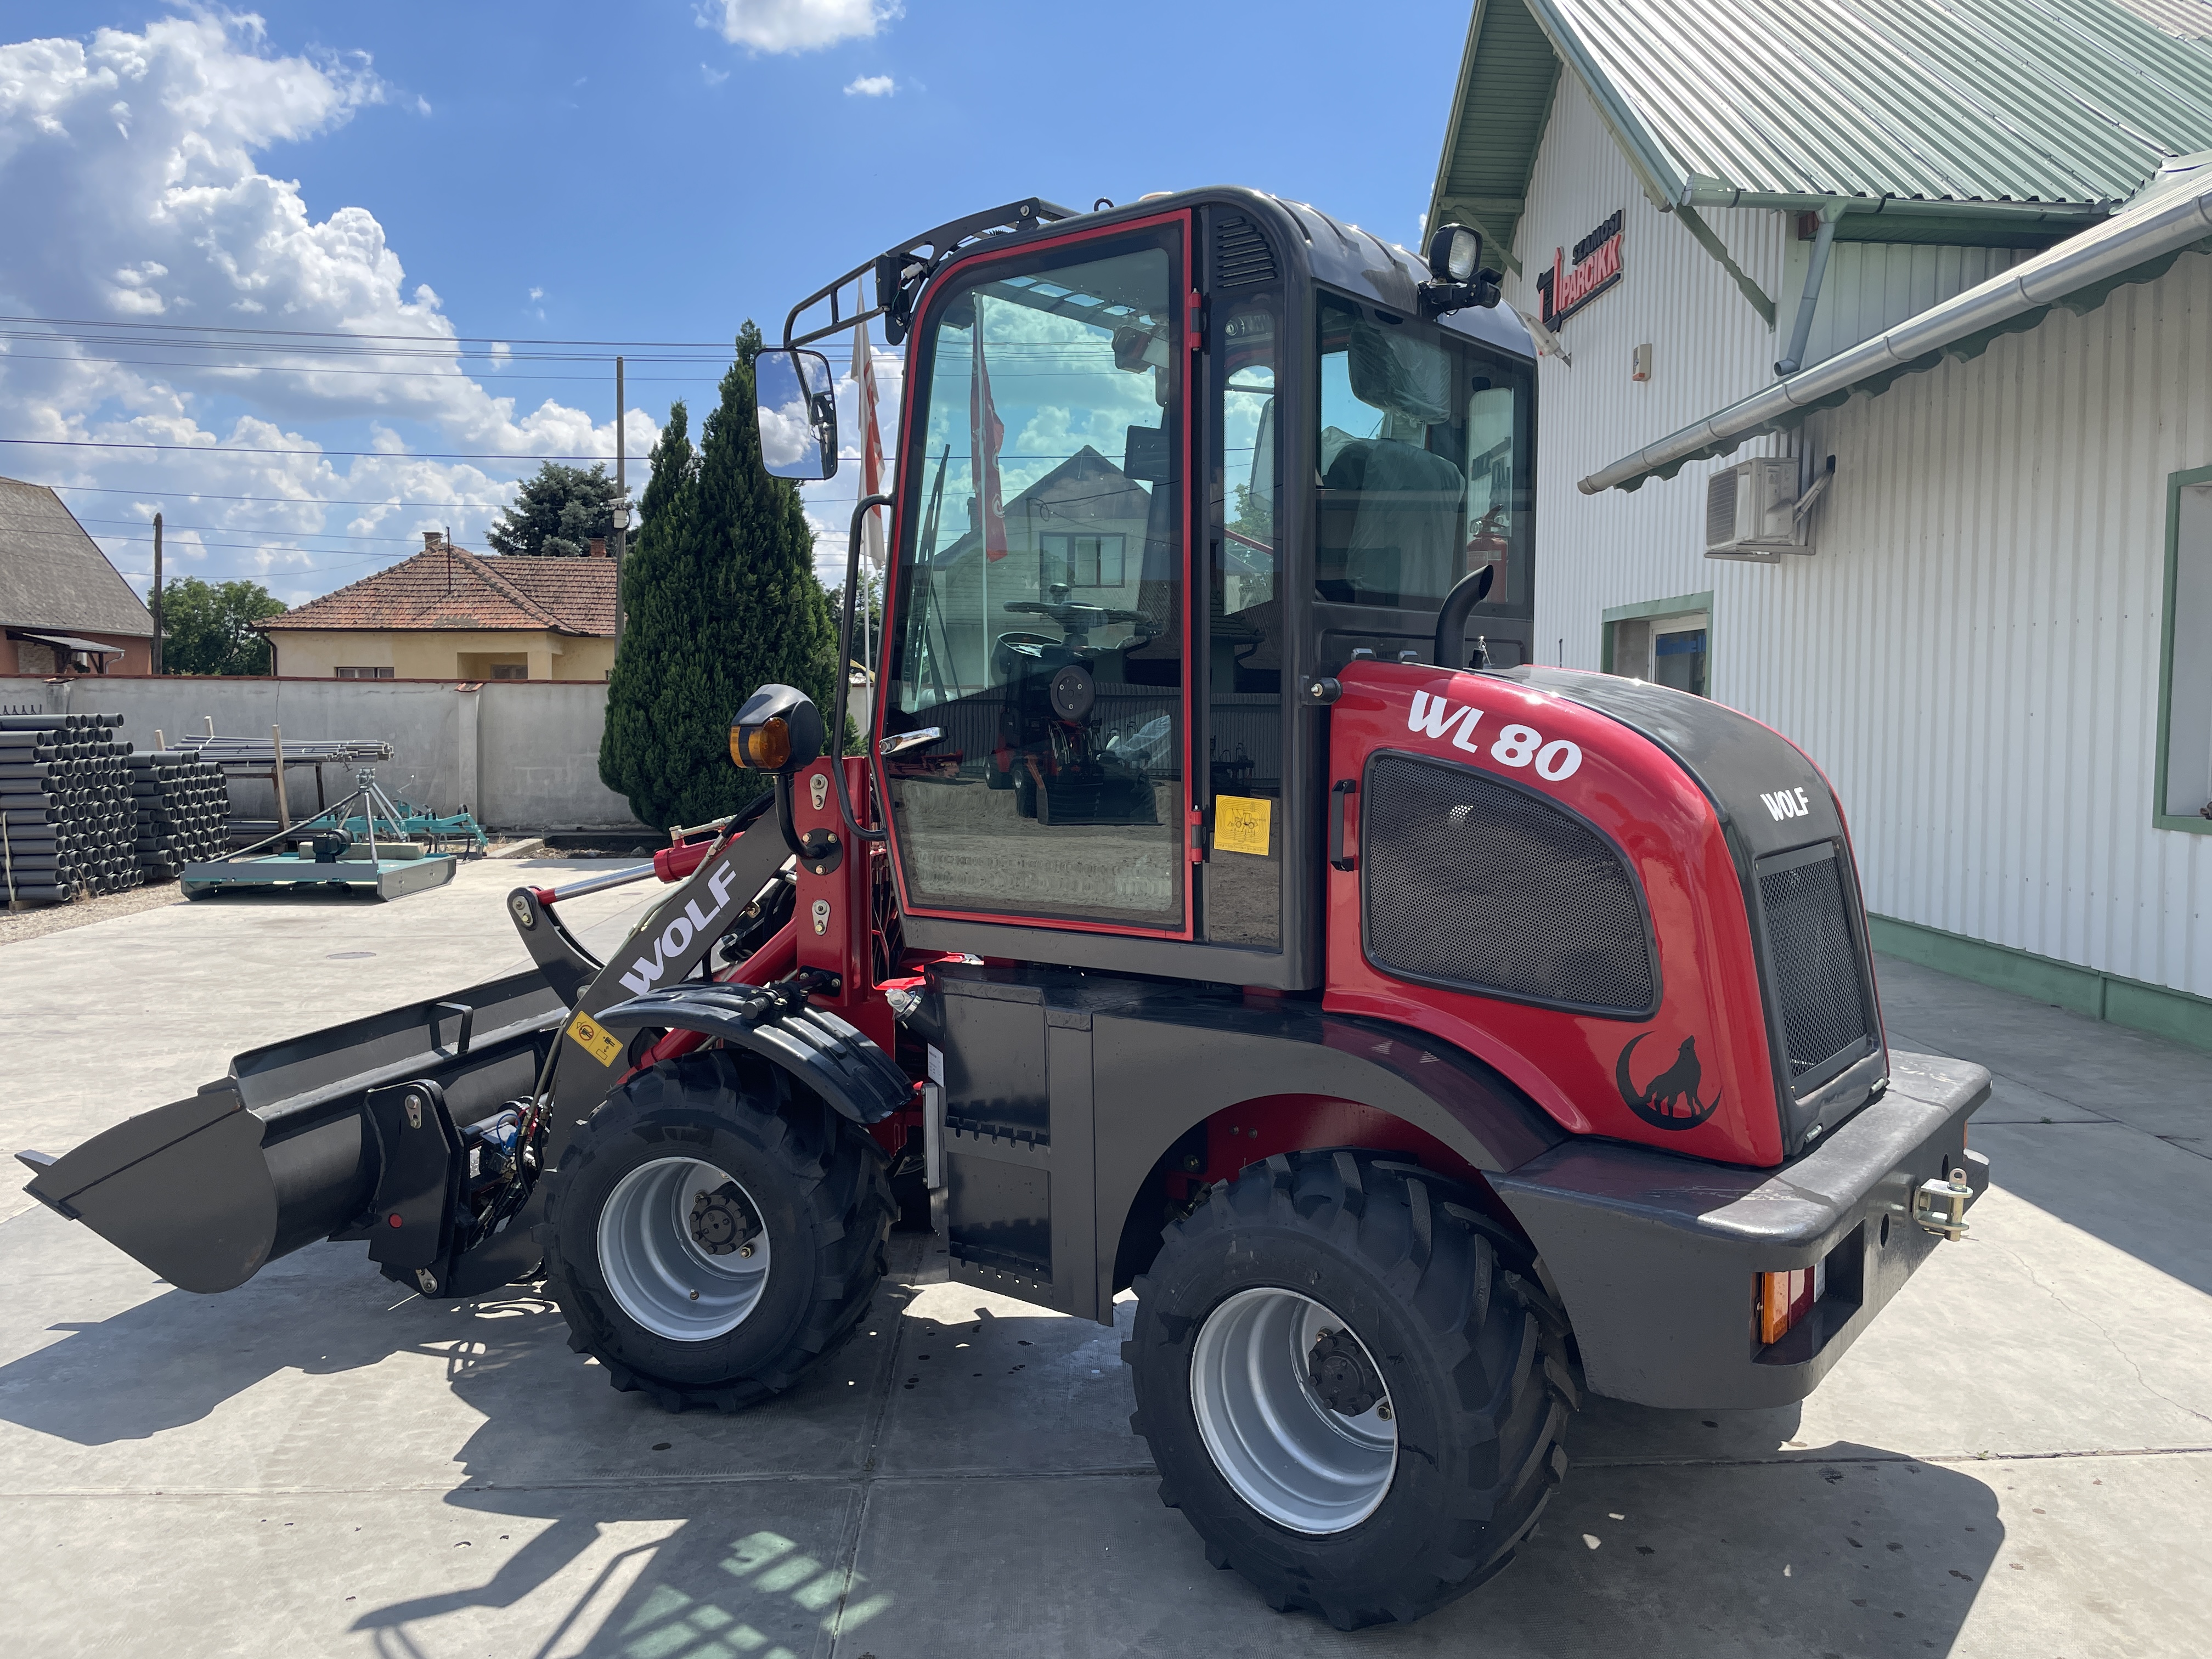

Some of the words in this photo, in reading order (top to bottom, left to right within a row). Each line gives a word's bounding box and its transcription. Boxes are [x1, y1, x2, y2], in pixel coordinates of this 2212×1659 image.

[1572, 210, 1622, 265] SZAMOSI
[1408, 690, 1485, 753] WL
[1491, 724, 1582, 781] 80
[1760, 787, 1809, 821] WOLF
[619, 860, 736, 996] WOLF
